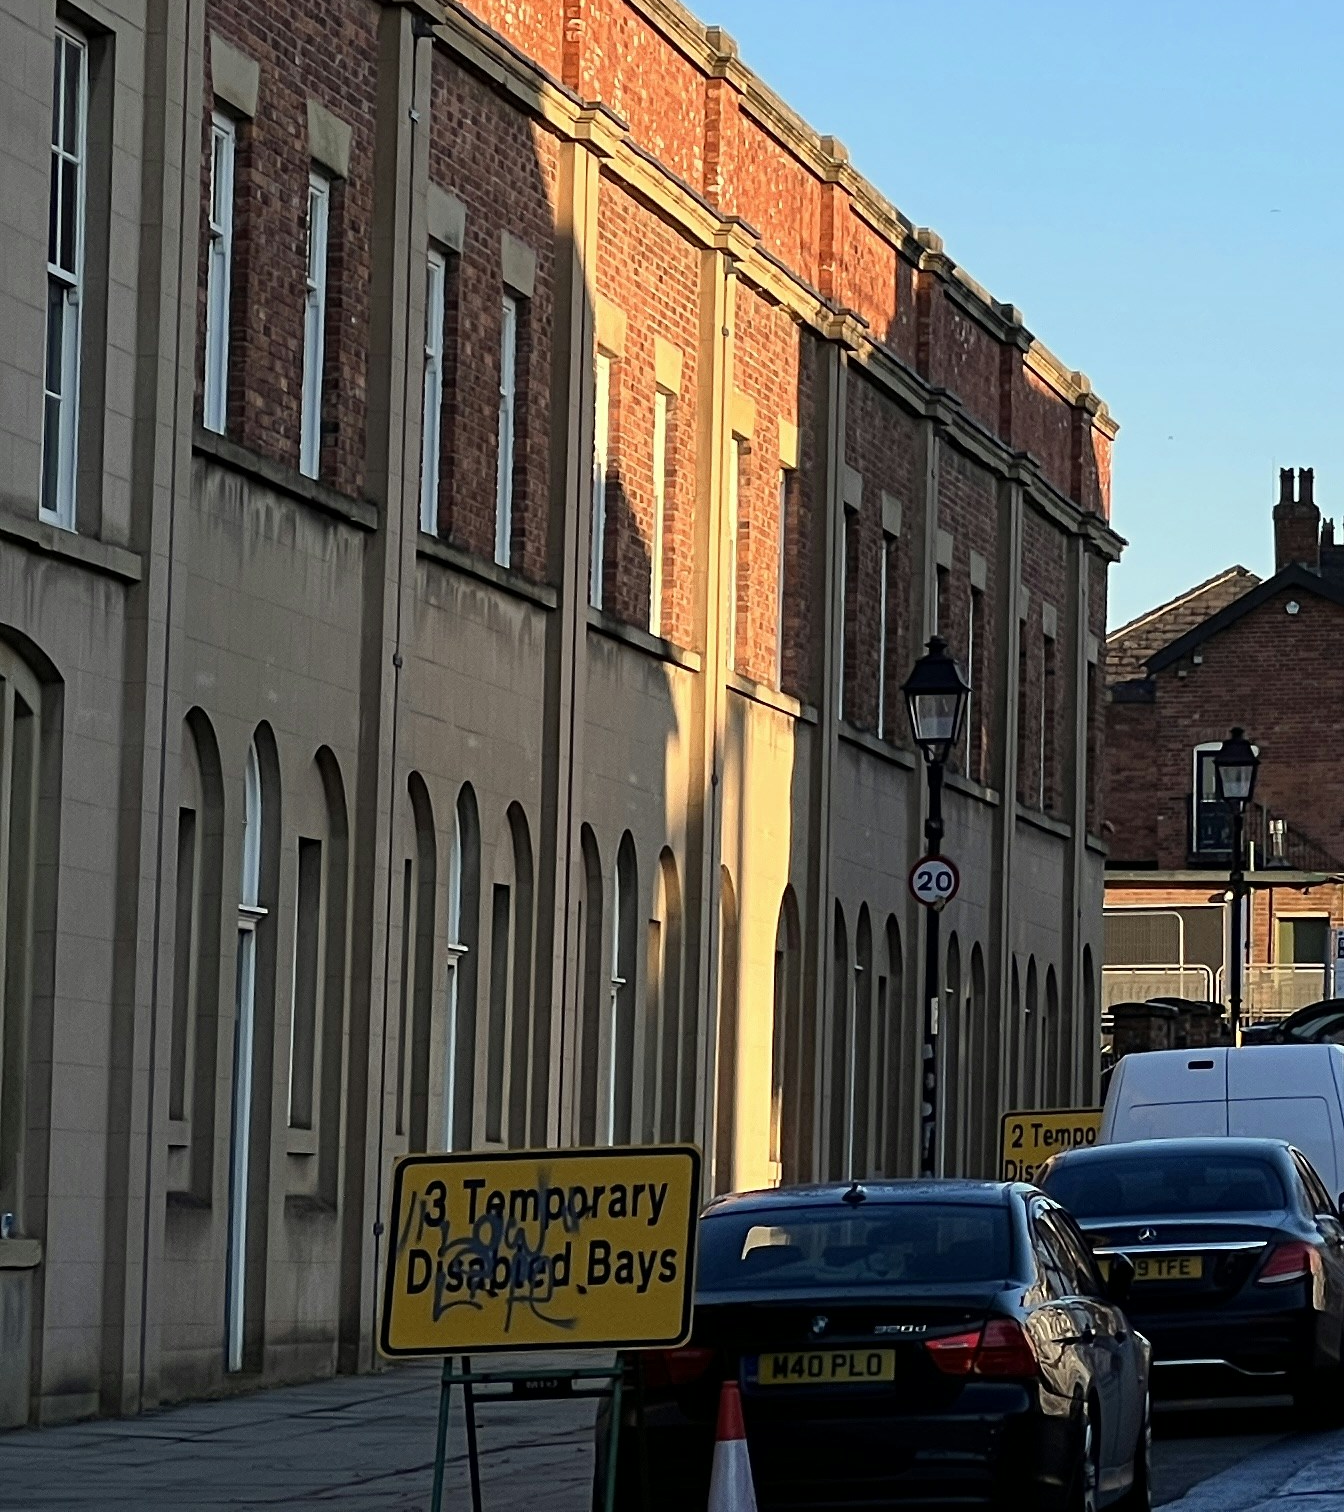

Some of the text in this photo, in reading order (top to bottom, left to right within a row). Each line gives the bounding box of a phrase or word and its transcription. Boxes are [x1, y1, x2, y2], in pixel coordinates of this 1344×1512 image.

[917, 870, 952, 892] 20
[1011, 1123, 1097, 1149] 2 Tempo
[424, 1178, 669, 1230] 3 Temporary
[406, 1239, 677, 1294] Disabled Bays
[1154, 1257, 1191, 1277] TFE
